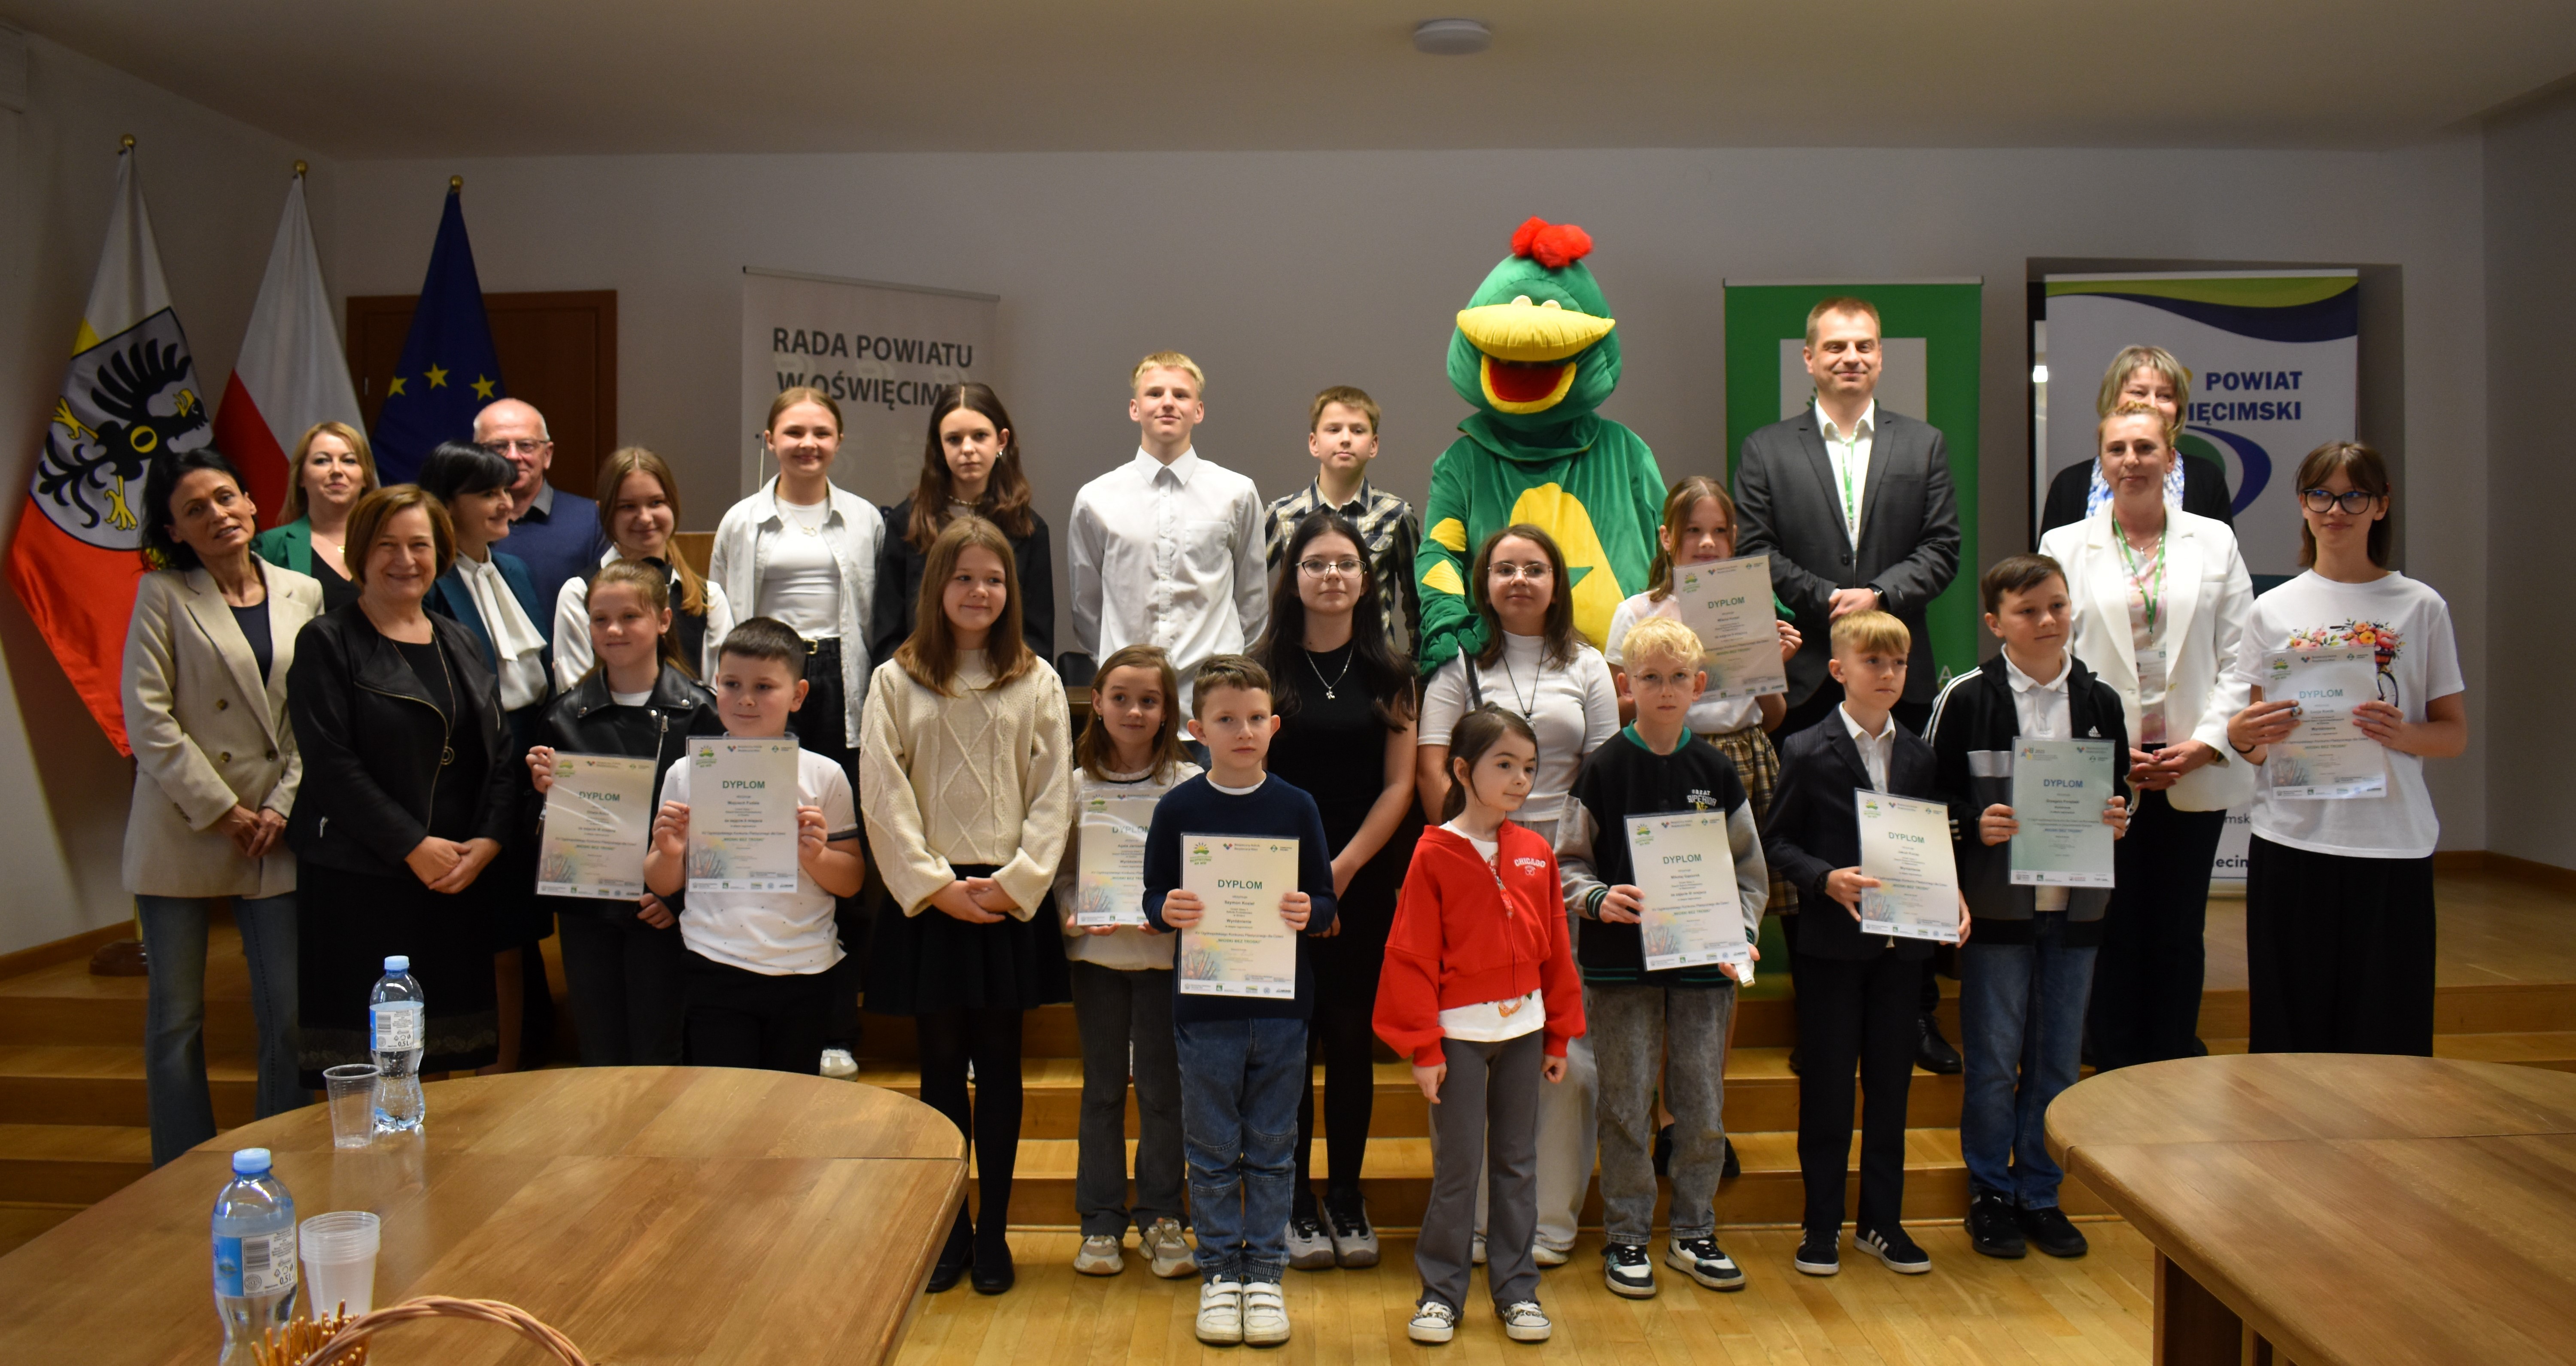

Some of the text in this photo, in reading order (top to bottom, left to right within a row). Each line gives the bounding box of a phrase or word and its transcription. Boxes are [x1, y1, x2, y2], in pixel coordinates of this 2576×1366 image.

[774, 328, 972, 367] RADA POWIATU
[2206, 370, 2303, 391] POWIAT
[811, 370, 950, 410] OŚWIĘCIM
[2188, 401, 2301, 426] IĘCIMSKI
[1707, 596, 1745, 609] DYPLOM
[2300, 689, 2343, 698] DYPLOM
[722, 780, 766, 789] DYPLOM
[2044, 779, 2084, 788] DYPLOM
[578, 791, 620, 801] DYPLOM
[1686, 794, 1717, 807] SUPERIOR
[1888, 832, 1925, 844] DYPLOM
[1514, 857, 1546, 868] CHICAGO
[1662, 854, 1702, 864] DYPLOM
[1218, 879, 1263, 889] DYPLOM
